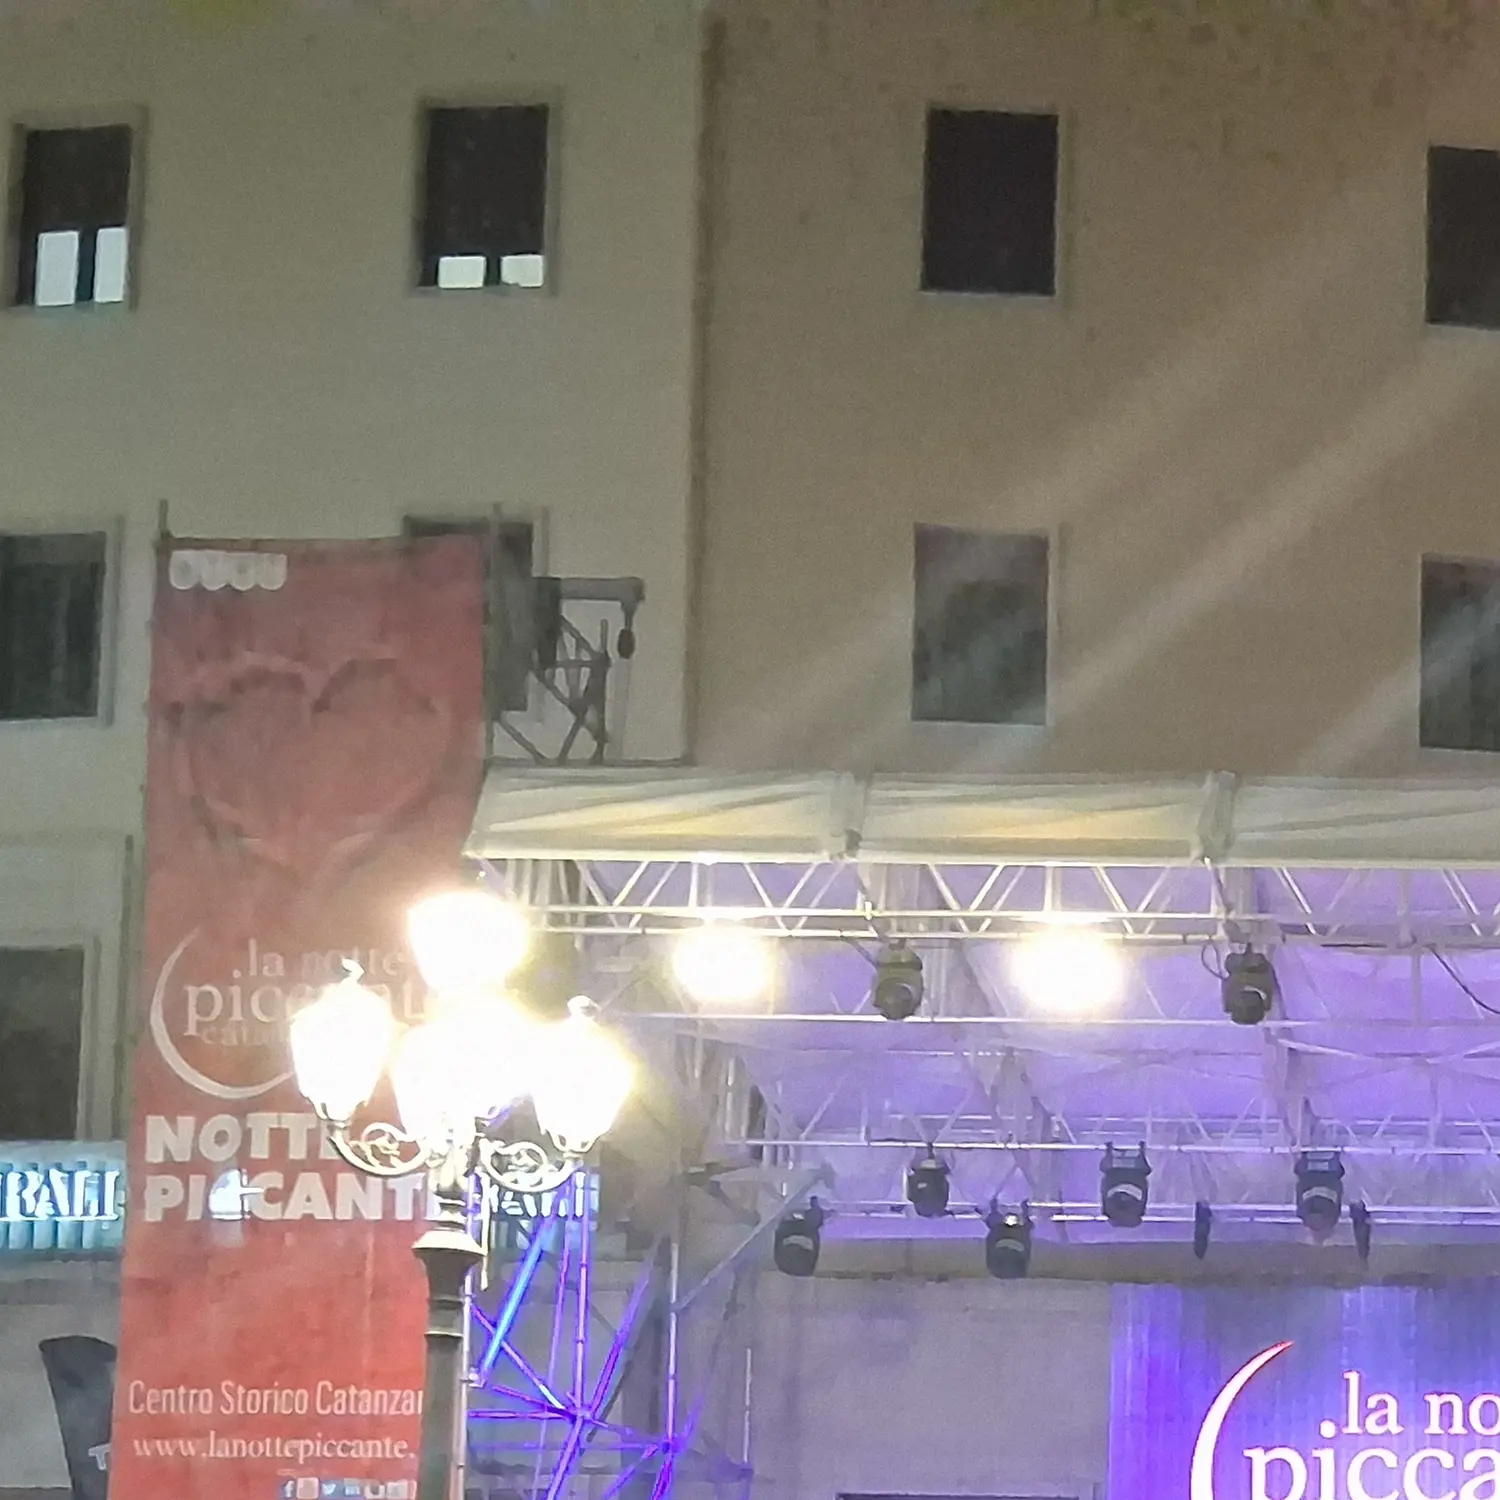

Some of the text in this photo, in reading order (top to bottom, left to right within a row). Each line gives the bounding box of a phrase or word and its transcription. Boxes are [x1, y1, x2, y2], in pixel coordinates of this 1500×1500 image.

[128, 1379, 214, 1416] Centro
[219, 1379, 310, 1416] Storico
[1340, 1369, 1405, 1437] la
